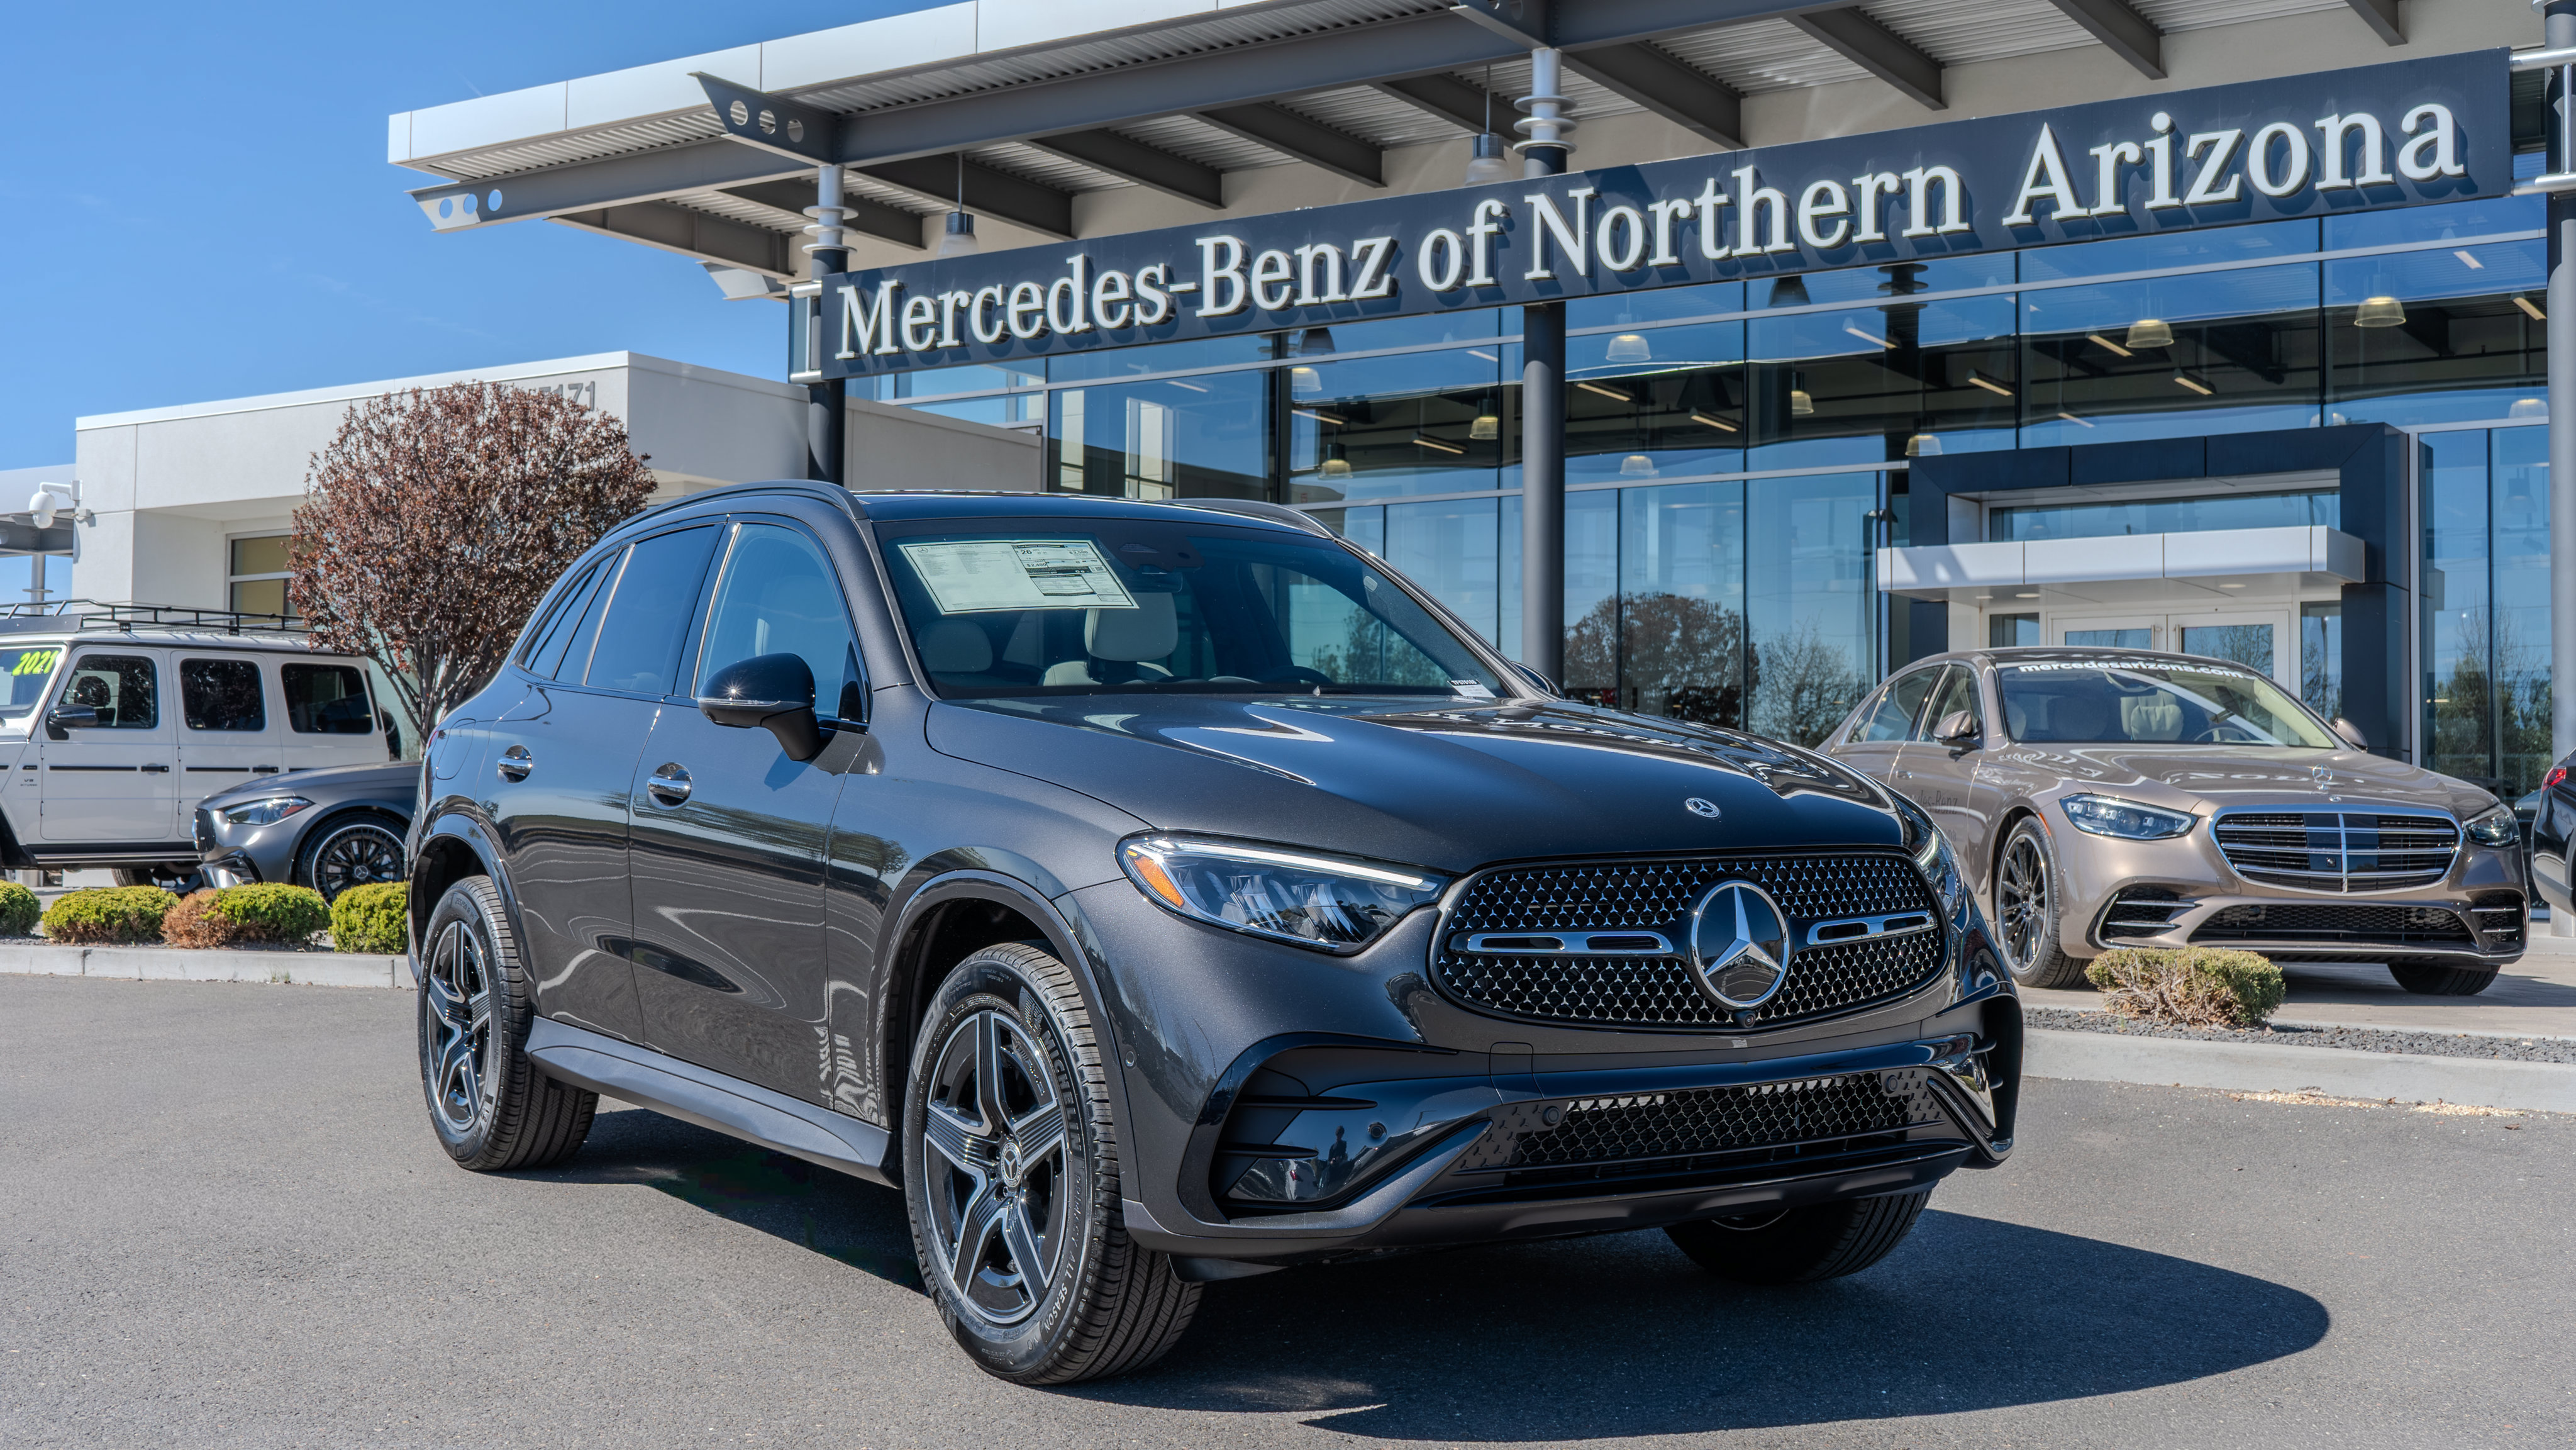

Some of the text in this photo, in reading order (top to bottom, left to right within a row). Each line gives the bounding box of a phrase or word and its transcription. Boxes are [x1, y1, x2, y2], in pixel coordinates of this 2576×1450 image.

[835, 103, 2464, 360] Mercedes-Benz of Northern Arizona
[11, 650, 60, 676] 2021
[2018, 661, 2244, 679] mercedesarizona.com
[1041, 1030, 1082, 1152] MICHELIN
[1065, 1251, 1076, 1280] ALL
[1043, 1282, 1068, 1334] SEASON
